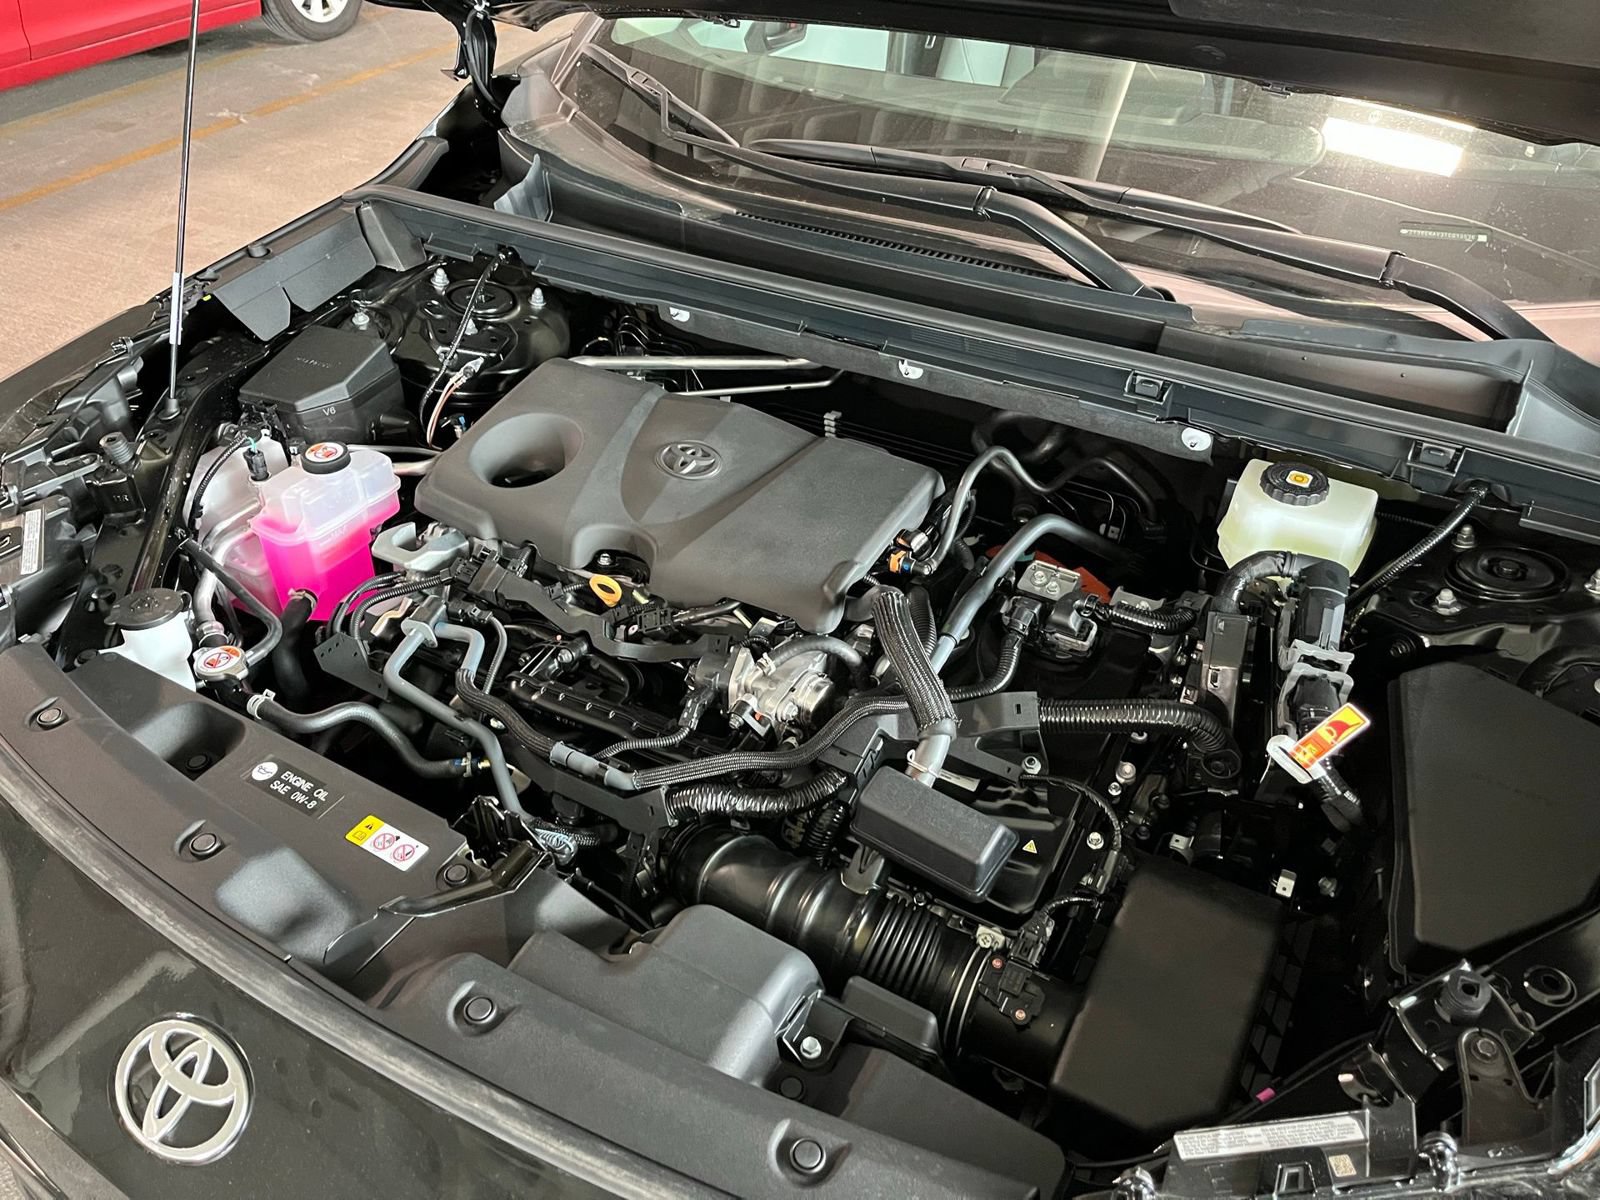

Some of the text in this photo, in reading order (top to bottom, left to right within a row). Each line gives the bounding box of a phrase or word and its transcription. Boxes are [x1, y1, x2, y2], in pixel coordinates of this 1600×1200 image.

[322, 406, 336, 416] V6
[270, 780, 317, 809] SAE 0W-8
[281, 771, 329, 801] ENGINE OIL
